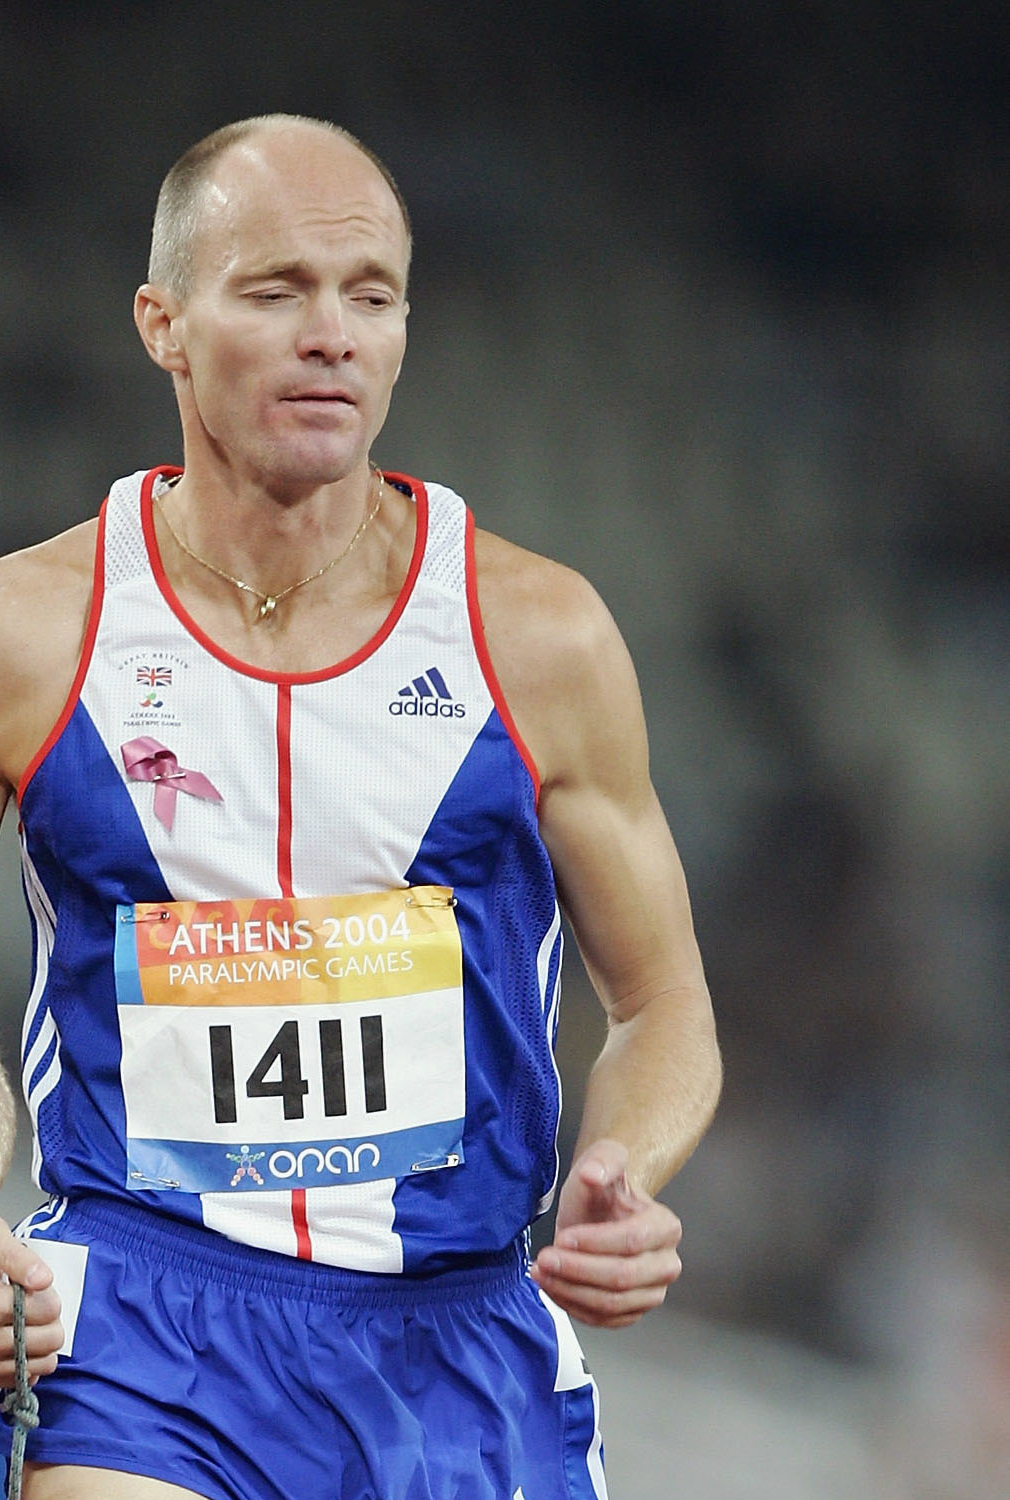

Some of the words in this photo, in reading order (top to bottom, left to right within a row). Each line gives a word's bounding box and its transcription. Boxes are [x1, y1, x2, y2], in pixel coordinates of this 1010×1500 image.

[389, 697, 466, 719] adidas
[168, 918, 314, 956] ATHENS
[323, 911, 411, 949] 2004
[168, 957, 320, 986] PARALYMPIC
[325, 951, 414, 979] GAMES
[208, 1014, 387, 1124] 1411
